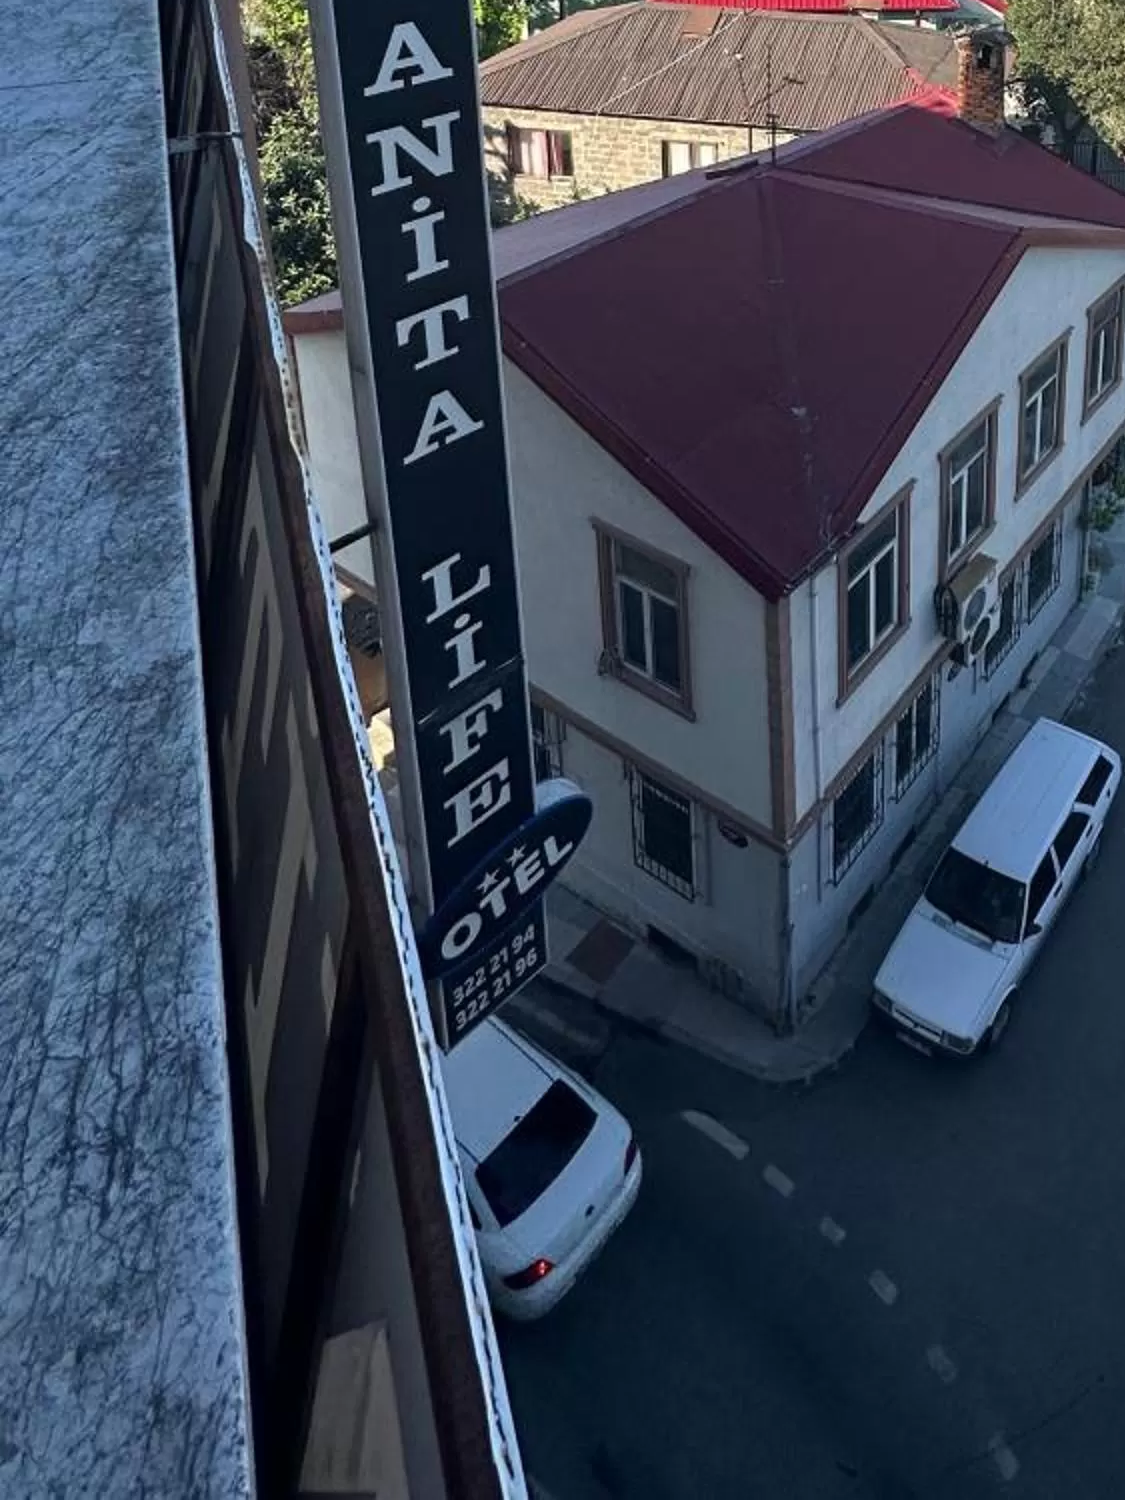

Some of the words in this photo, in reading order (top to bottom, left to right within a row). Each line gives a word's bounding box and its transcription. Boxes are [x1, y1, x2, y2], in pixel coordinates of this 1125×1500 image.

[441, 836, 573, 961] OTEL
[453, 966, 487, 1008] 322
[512, 924, 536, 956] 94
[456, 989, 491, 1032] 322
[515, 948, 538, 976] 96
